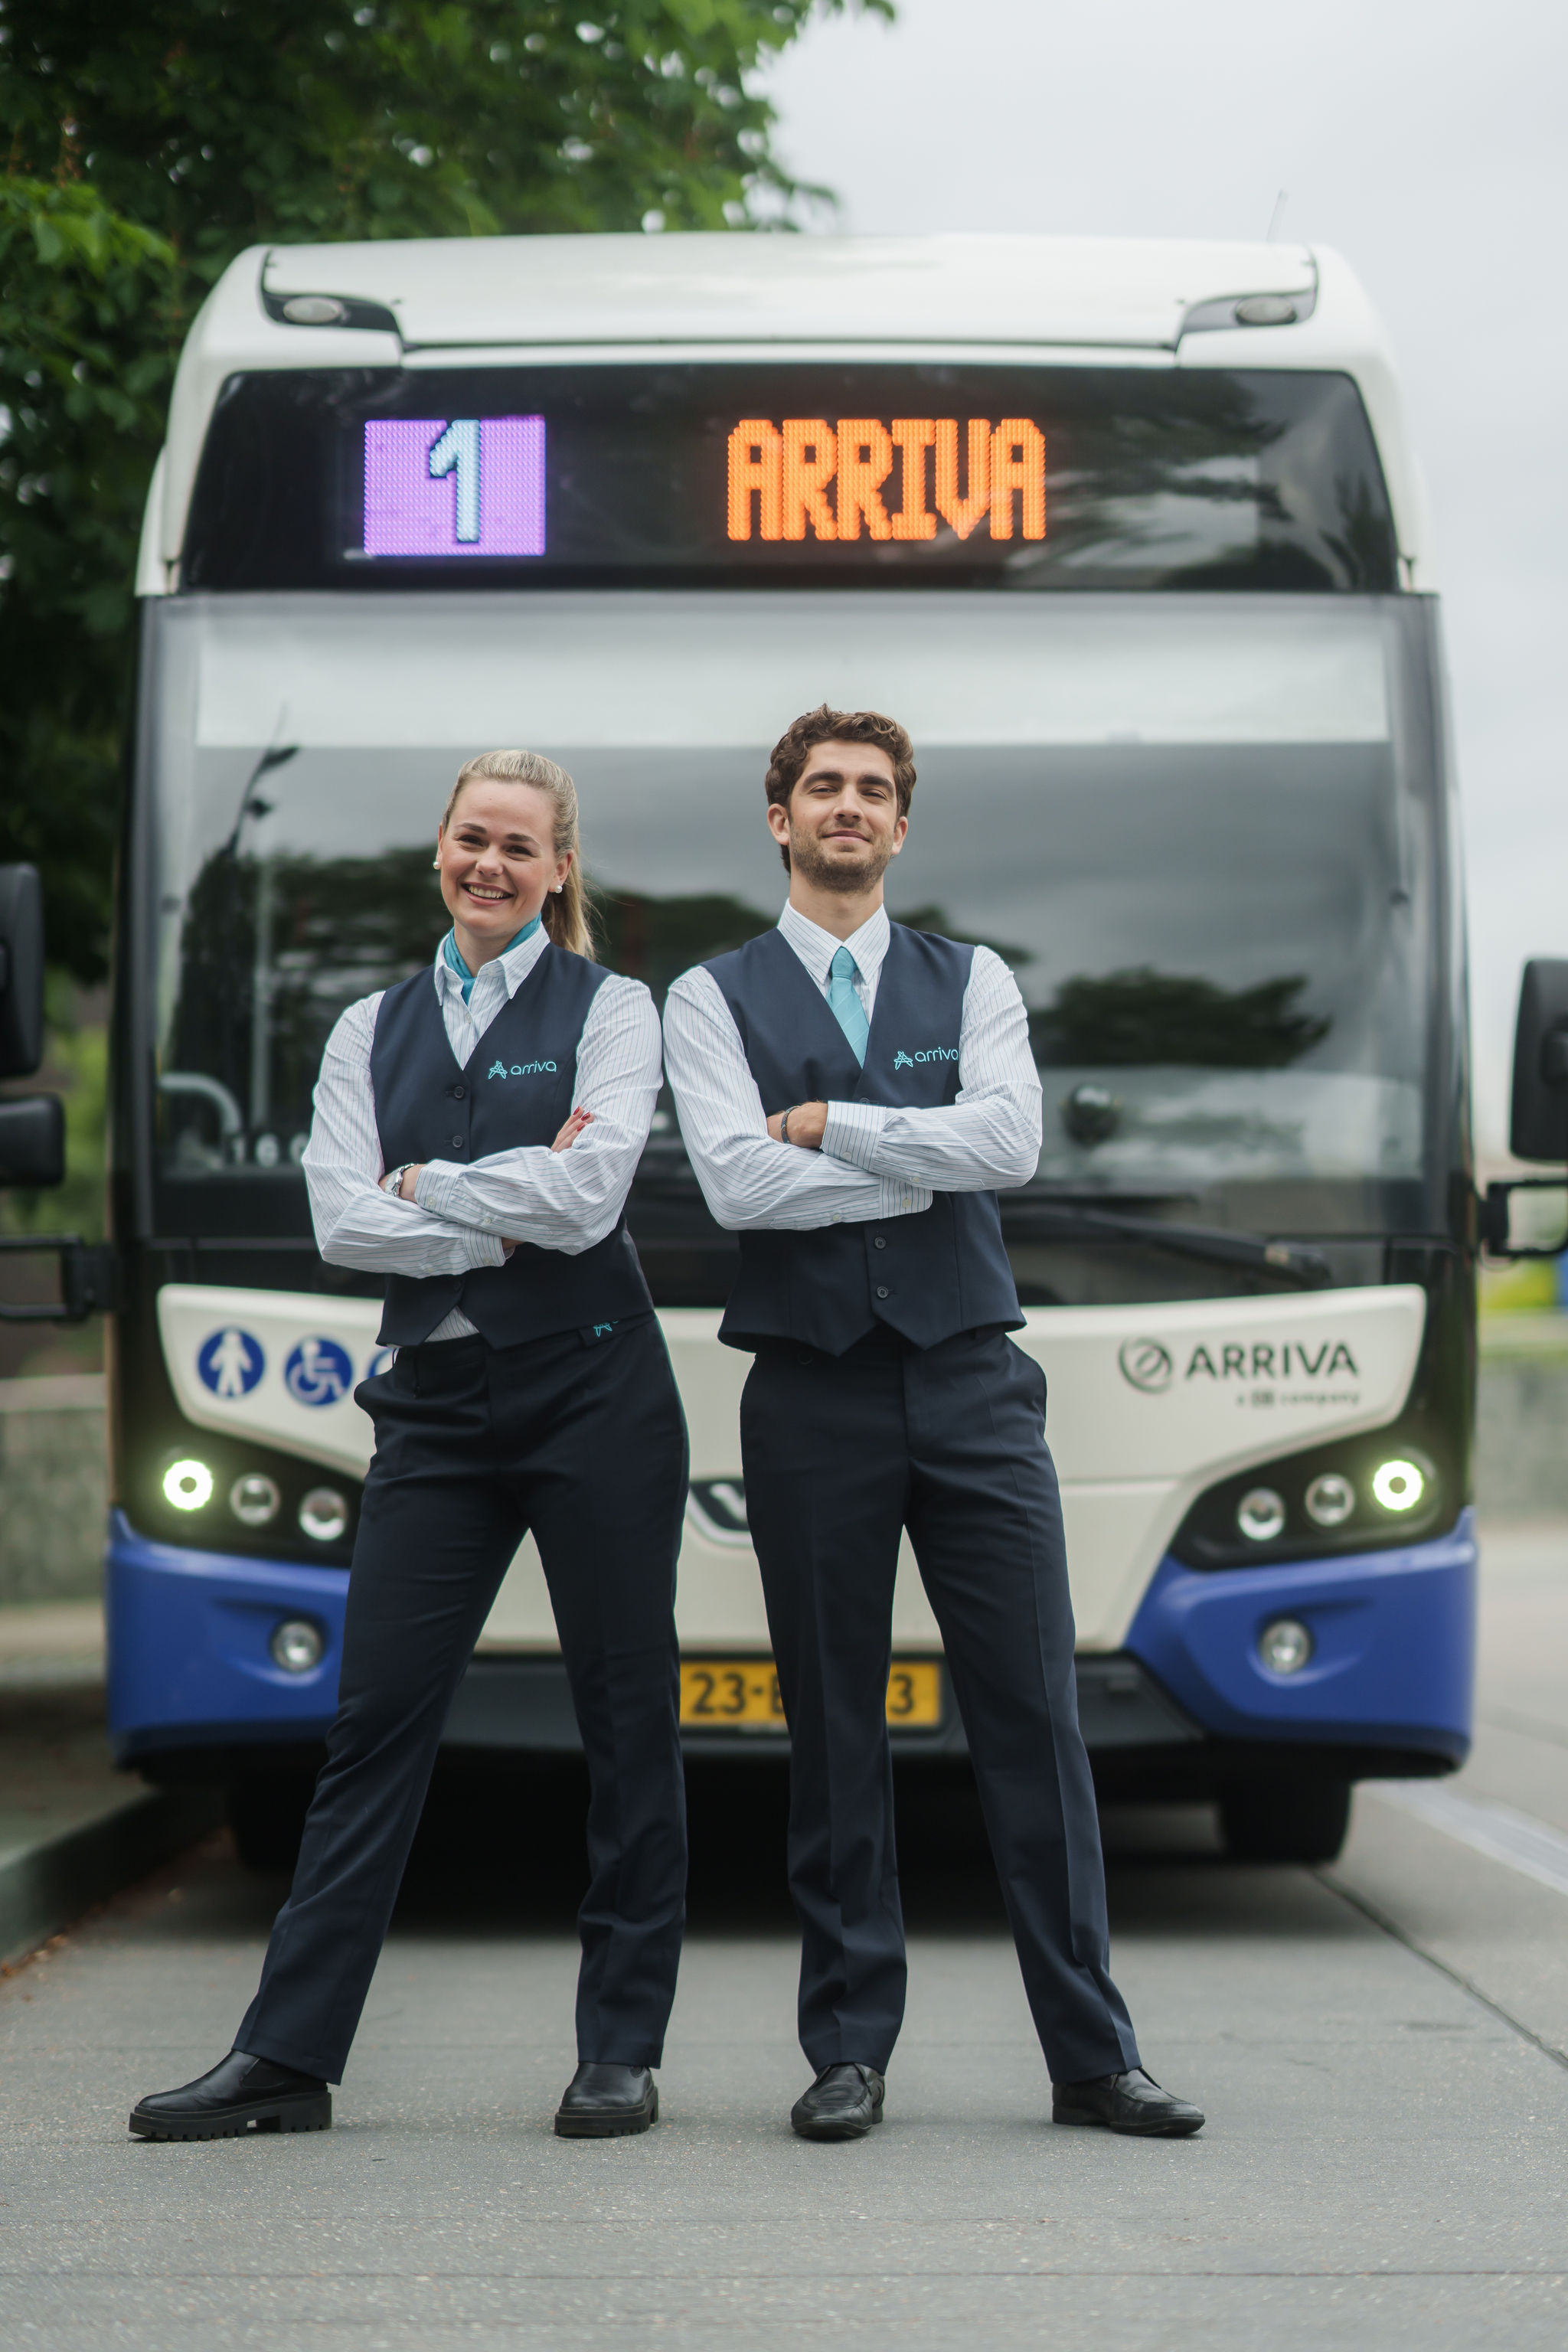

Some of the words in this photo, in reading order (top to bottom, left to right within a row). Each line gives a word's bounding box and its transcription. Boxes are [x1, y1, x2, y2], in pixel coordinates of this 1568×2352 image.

[429, 419, 481, 542] 1
[727, 419, 1047, 541] ARRIVA
[511, 1061, 557, 1075] arriva
[915, 1047, 959, 1062] arriva
[1186, 1343, 1358, 1379] ARRIVA
